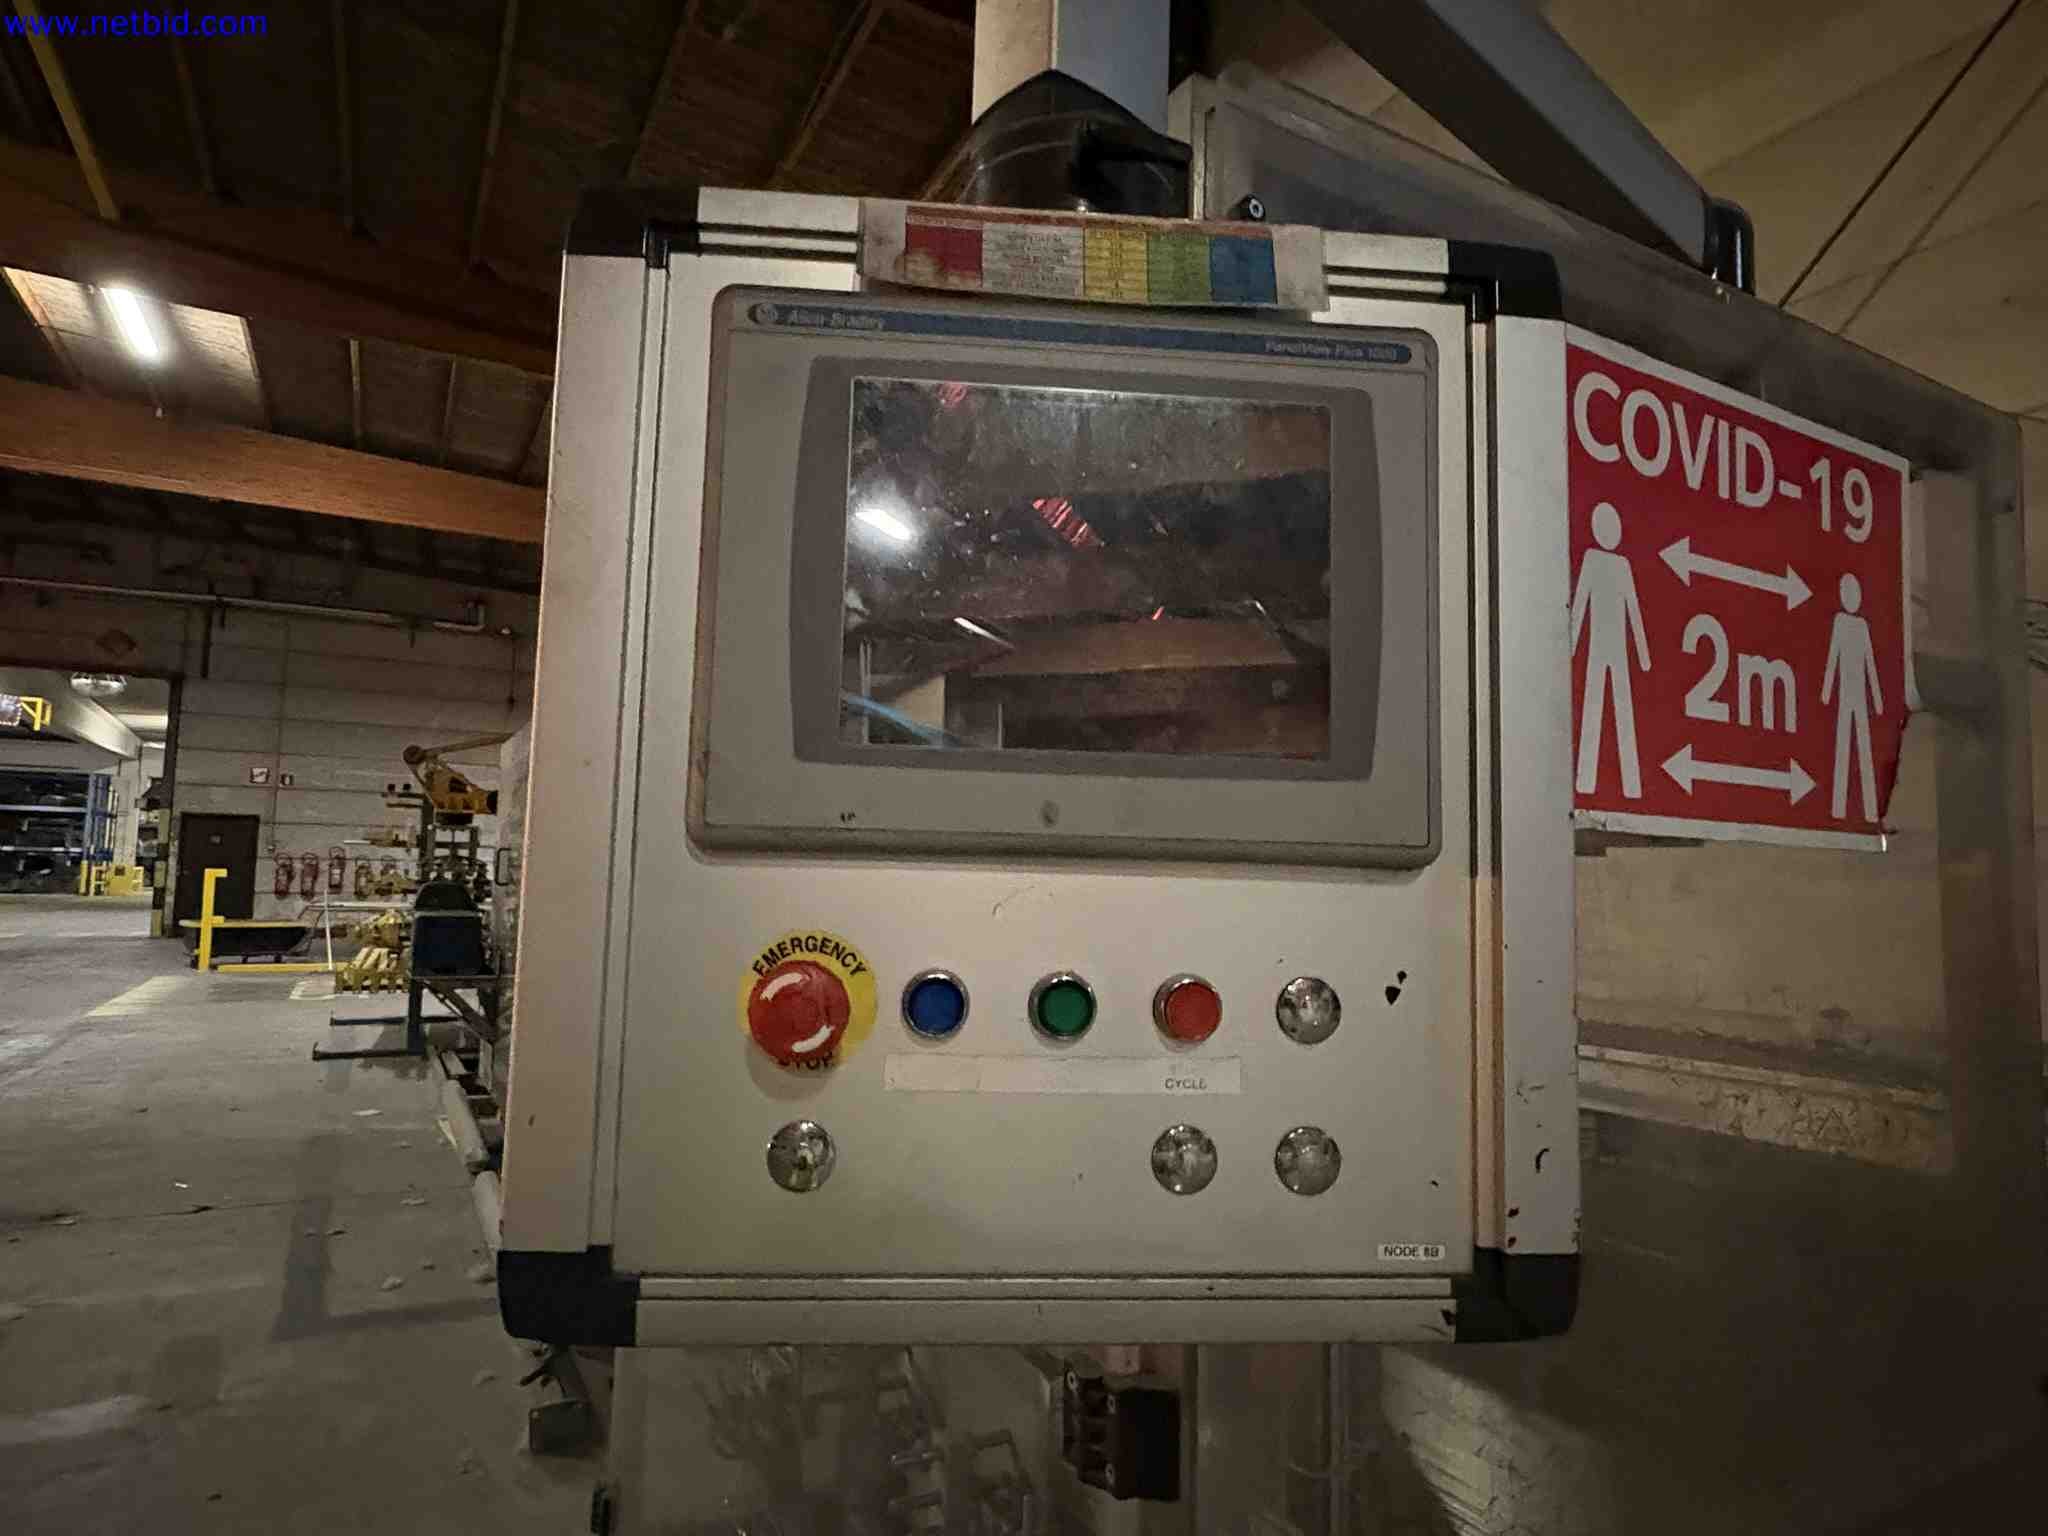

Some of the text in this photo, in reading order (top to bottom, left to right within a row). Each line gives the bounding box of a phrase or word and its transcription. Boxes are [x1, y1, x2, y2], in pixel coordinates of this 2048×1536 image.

[1573, 371, 1872, 543] COVID-19
[1681, 614, 1797, 733] 2m
[752, 935, 866, 976] EMERGENCY
[1164, 1078, 1207, 1090] CYCLE
[1383, 1246, 1418, 1257] NODE
